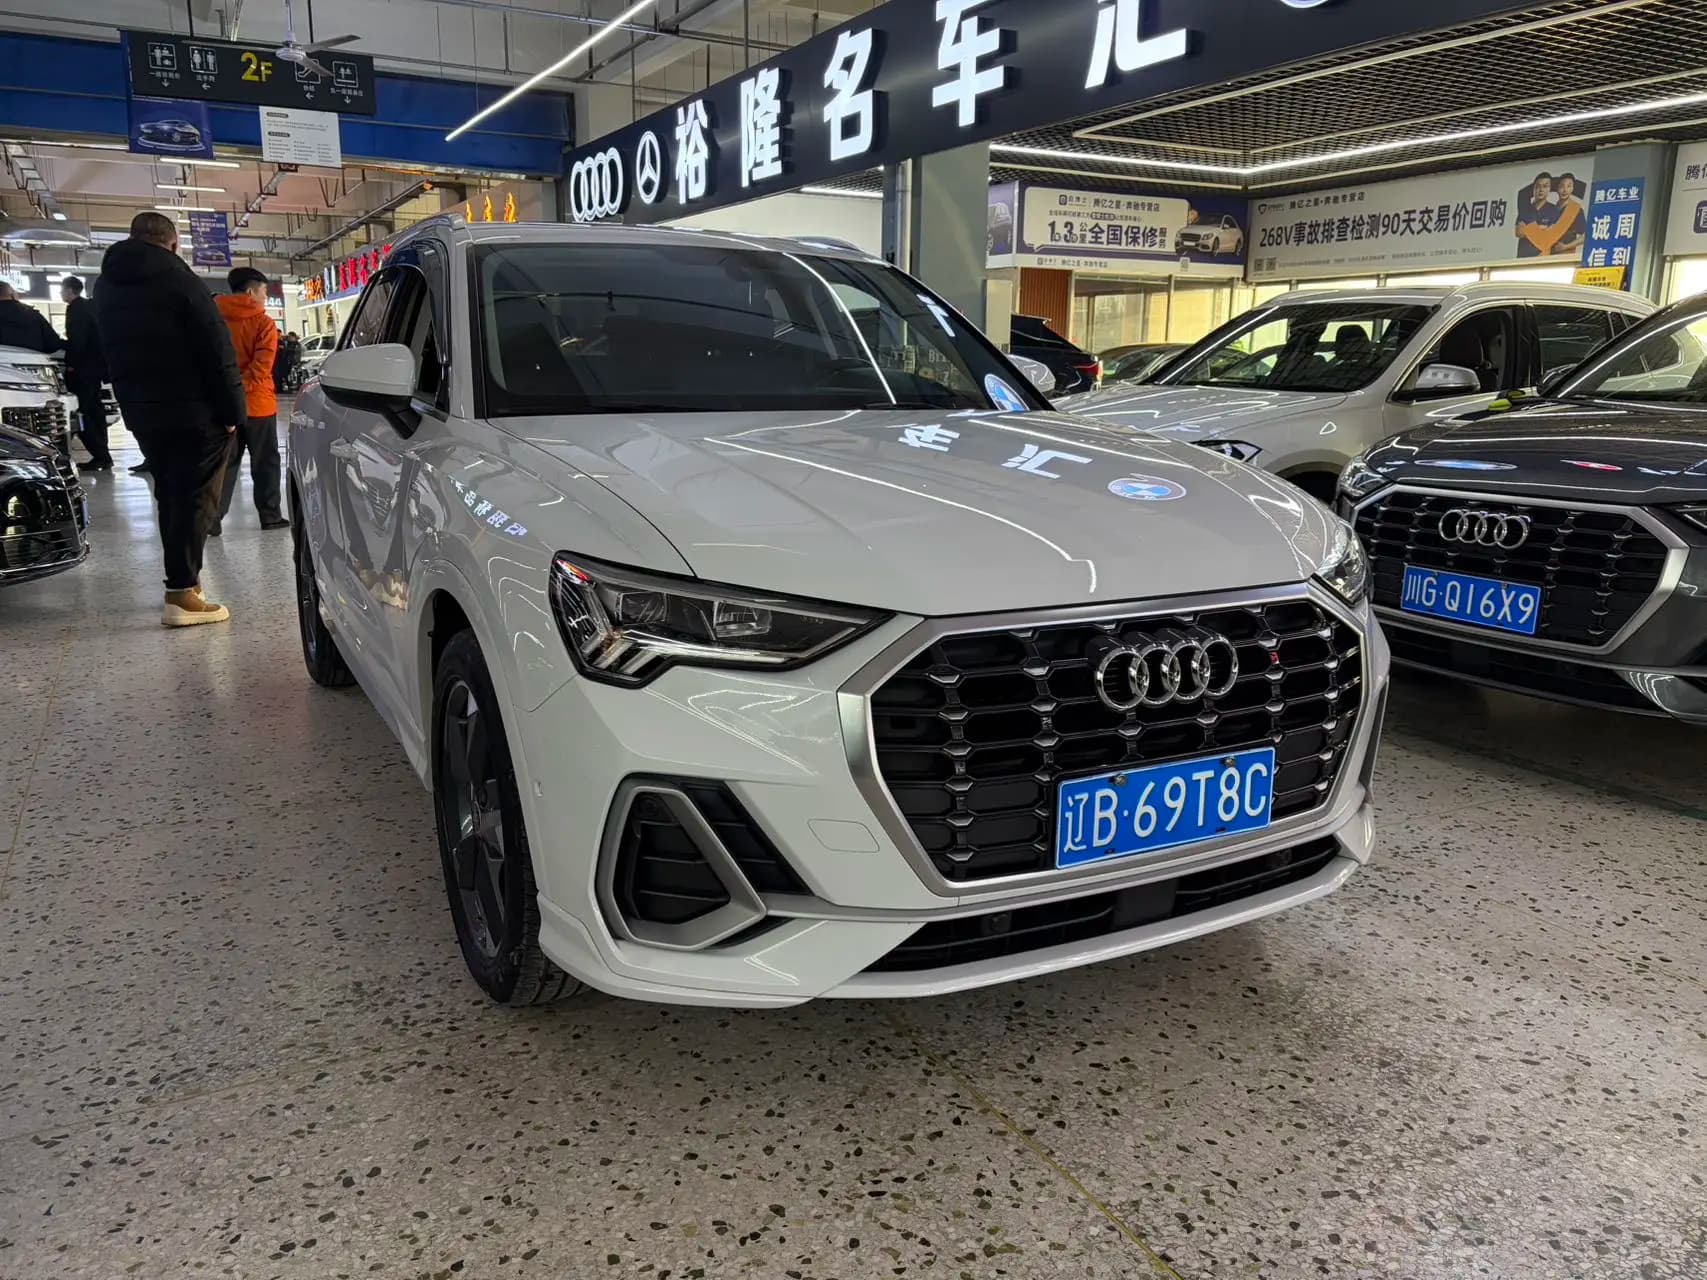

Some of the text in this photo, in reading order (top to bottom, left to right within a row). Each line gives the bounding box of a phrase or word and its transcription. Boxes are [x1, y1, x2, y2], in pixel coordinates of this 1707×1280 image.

[241, 51, 273, 83] 2F
[1259, 198, 1507, 248] 268V事故排查检测90天交易价回购
[1405, 574, 1535, 625] 川G·Q16X9
[1064, 762, 1269, 853] 辽B·69T8C
